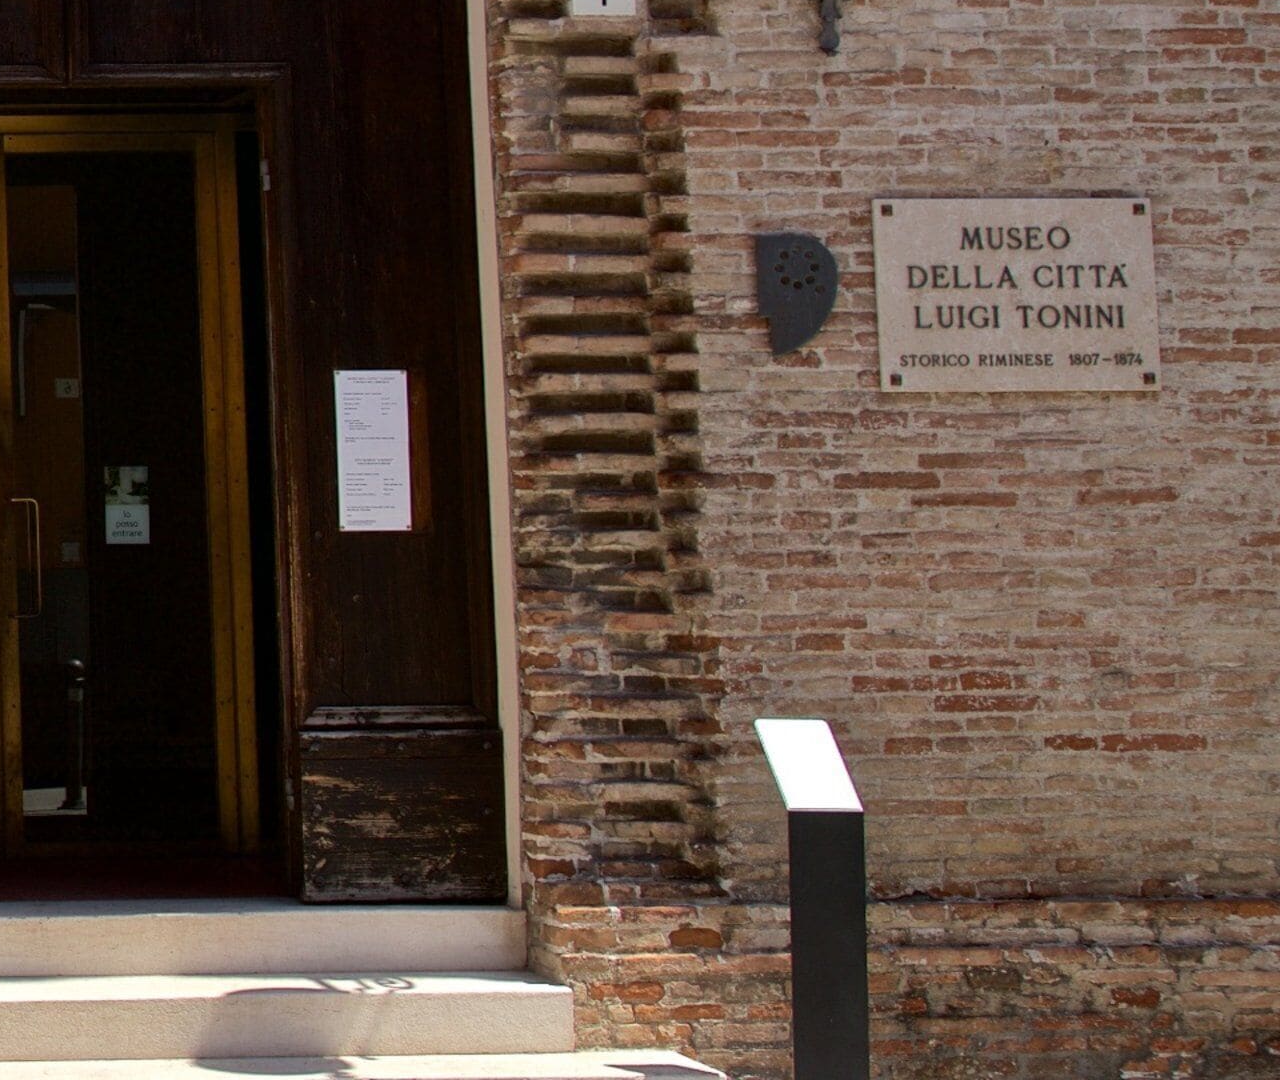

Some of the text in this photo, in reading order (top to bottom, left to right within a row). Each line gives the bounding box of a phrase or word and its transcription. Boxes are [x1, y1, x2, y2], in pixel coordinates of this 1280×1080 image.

[959, 226, 1071, 251] MUSEO
[907, 265, 1018, 290] DELLA
[914, 305, 1126, 330] LUIGI TONINI
[899, 353, 970, 368] STORICO
[979, 353, 1054, 368] RIMINESE
